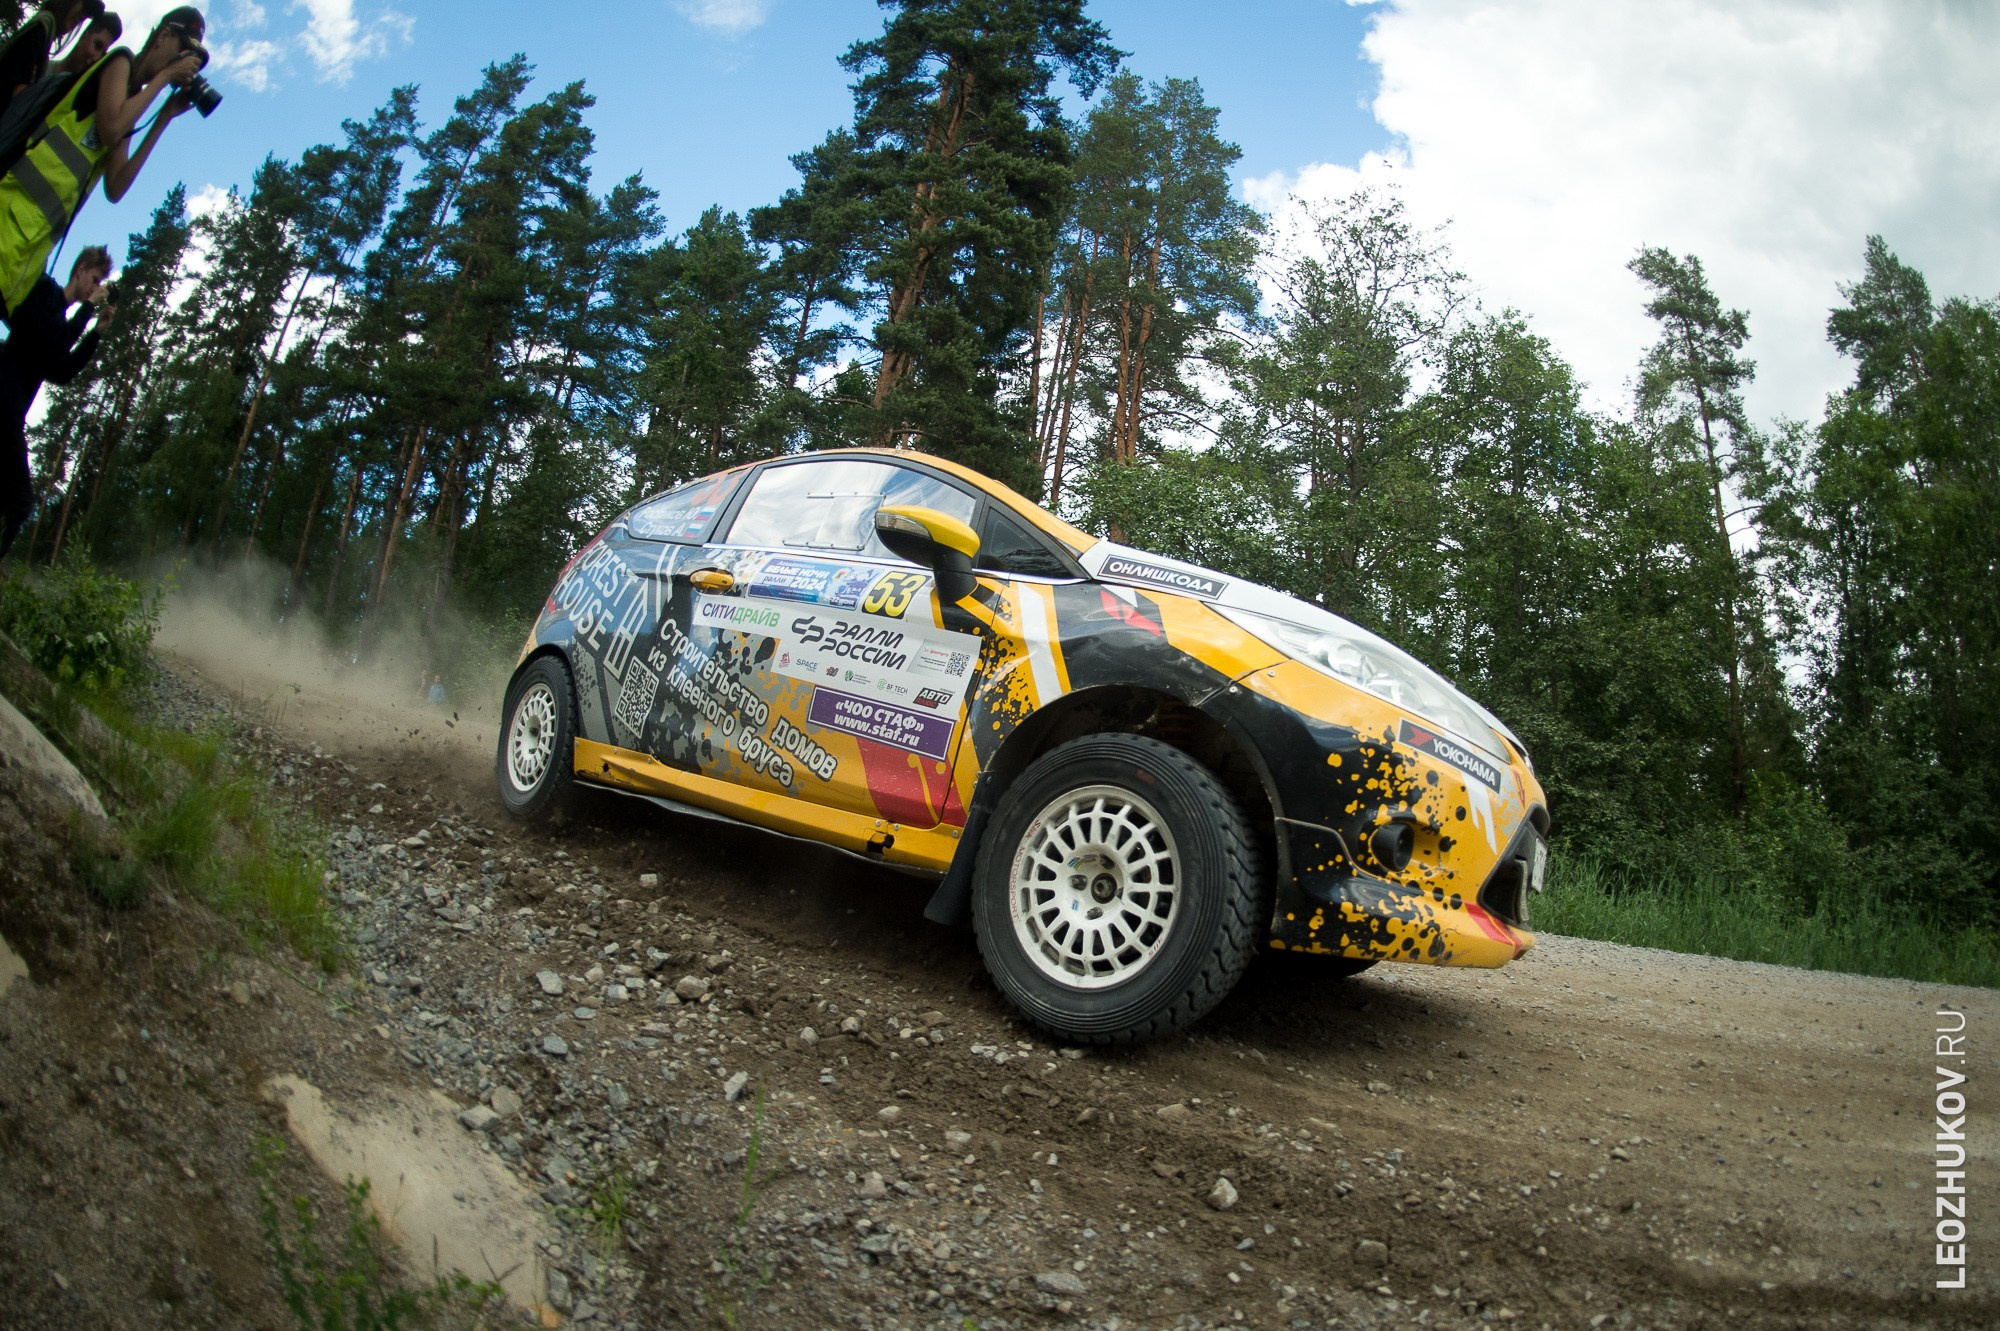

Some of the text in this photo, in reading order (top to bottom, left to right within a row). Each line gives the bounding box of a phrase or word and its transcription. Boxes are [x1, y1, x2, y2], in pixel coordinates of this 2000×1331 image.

[578, 539, 640, 607] FOREST
[762, 576, 787, 585] ралли
[765, 565, 799, 577] БЕЛЫЕ
[799, 568, 830, 580] НОЧИ
[789, 577, 826, 592] 2024
[554, 567, 614, 651] HOUSE
[864, 571, 926, 617] 53
[702, 602, 781, 628] СИТИДРАЙВ
[829, 620, 905, 649] РАЛЛИ
[796, 658, 819, 670] SPACE
[818, 637, 908, 670] РОССИИ
[660, 618, 838, 782] Строительство домов
[886, 683, 894, 691] BF
[894, 685, 909, 695] TECH
[920, 689, 951, 703] АВТО
[647, 645, 794, 787] из клееного бруса
[834, 713, 920, 747] www.staf.ru
[835, 700, 925, 732] «ЧОО СТАФ»
[1433, 738, 1496, 787] YOKOHAMA
[1010, 846, 1026, 921] MOTORSPORT
